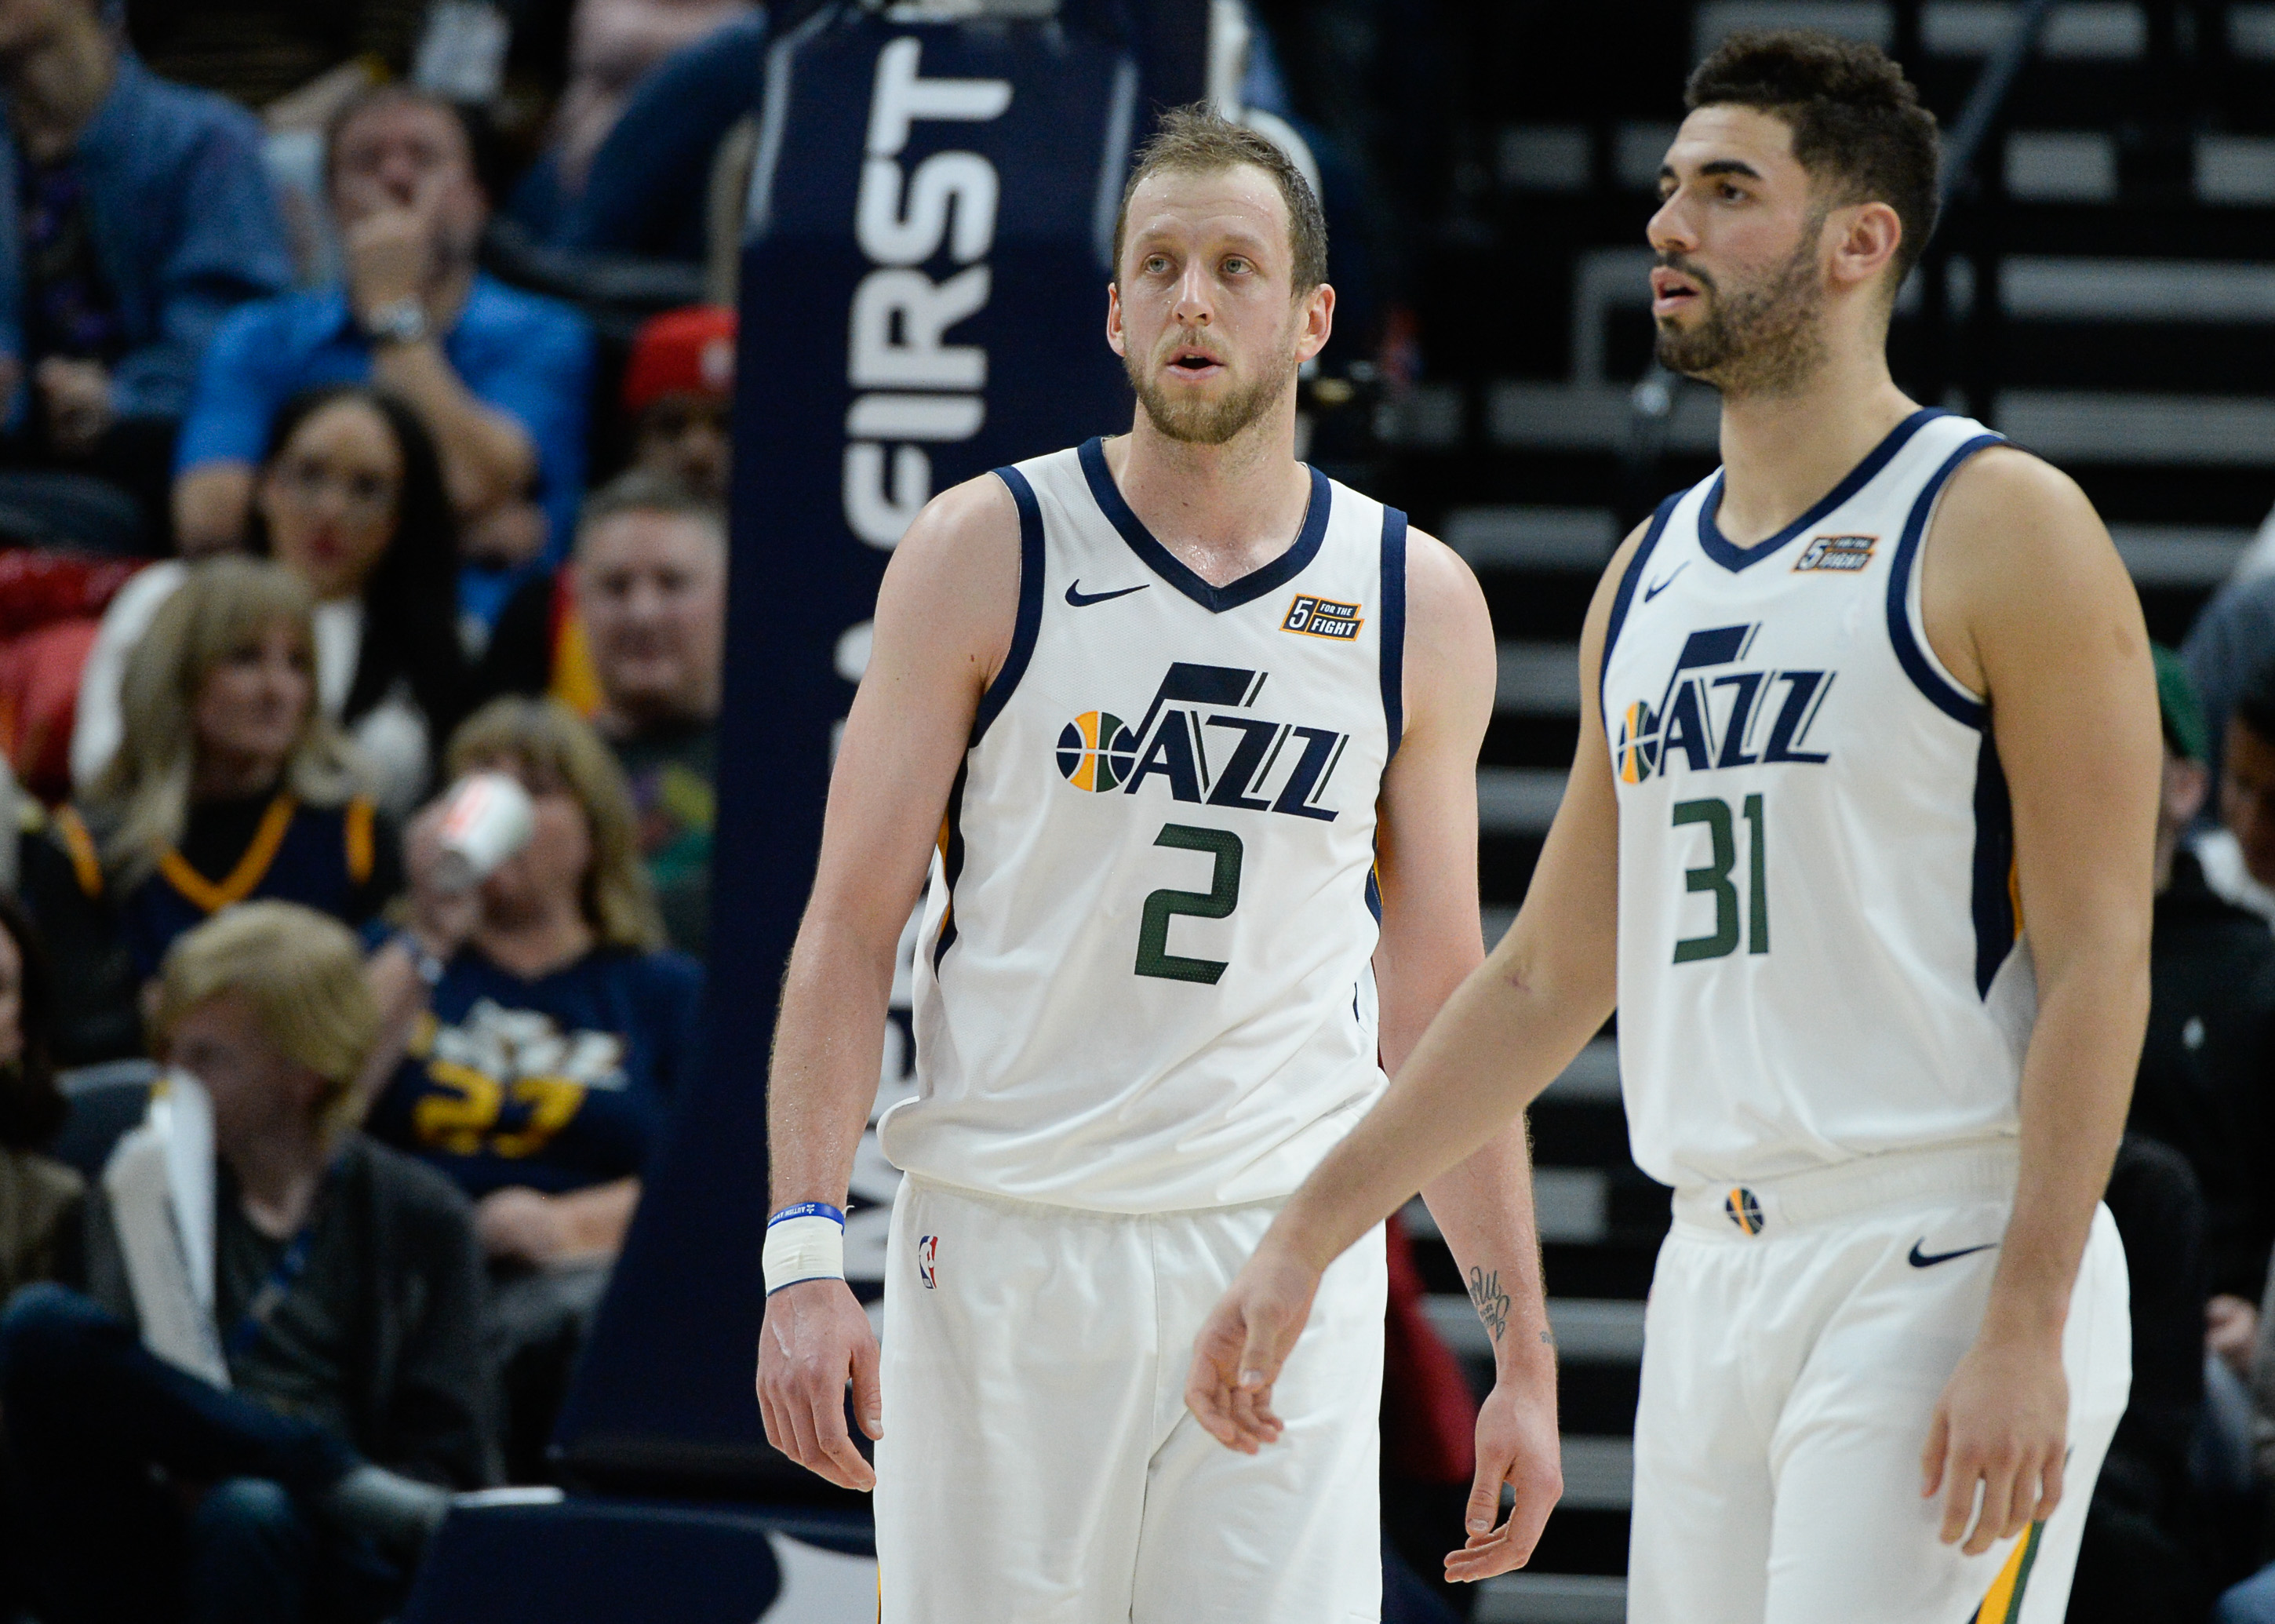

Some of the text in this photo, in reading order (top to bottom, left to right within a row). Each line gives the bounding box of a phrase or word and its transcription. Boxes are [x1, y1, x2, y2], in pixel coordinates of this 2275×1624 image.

[842, 38, 1014, 547] FIRST
[1289, 599, 1313, 628] 5
[1311, 617, 1356, 635] FIGHT
[1320, 603, 1353, 616] FOR THE
[1057, 662, 1349, 822] JAZZ
[1618, 621, 1838, 785] JAZZ
[1134, 823, 1243, 985] 2
[1672, 793, 1771, 964] 31
[784, 1206, 806, 1216] AUTISM
